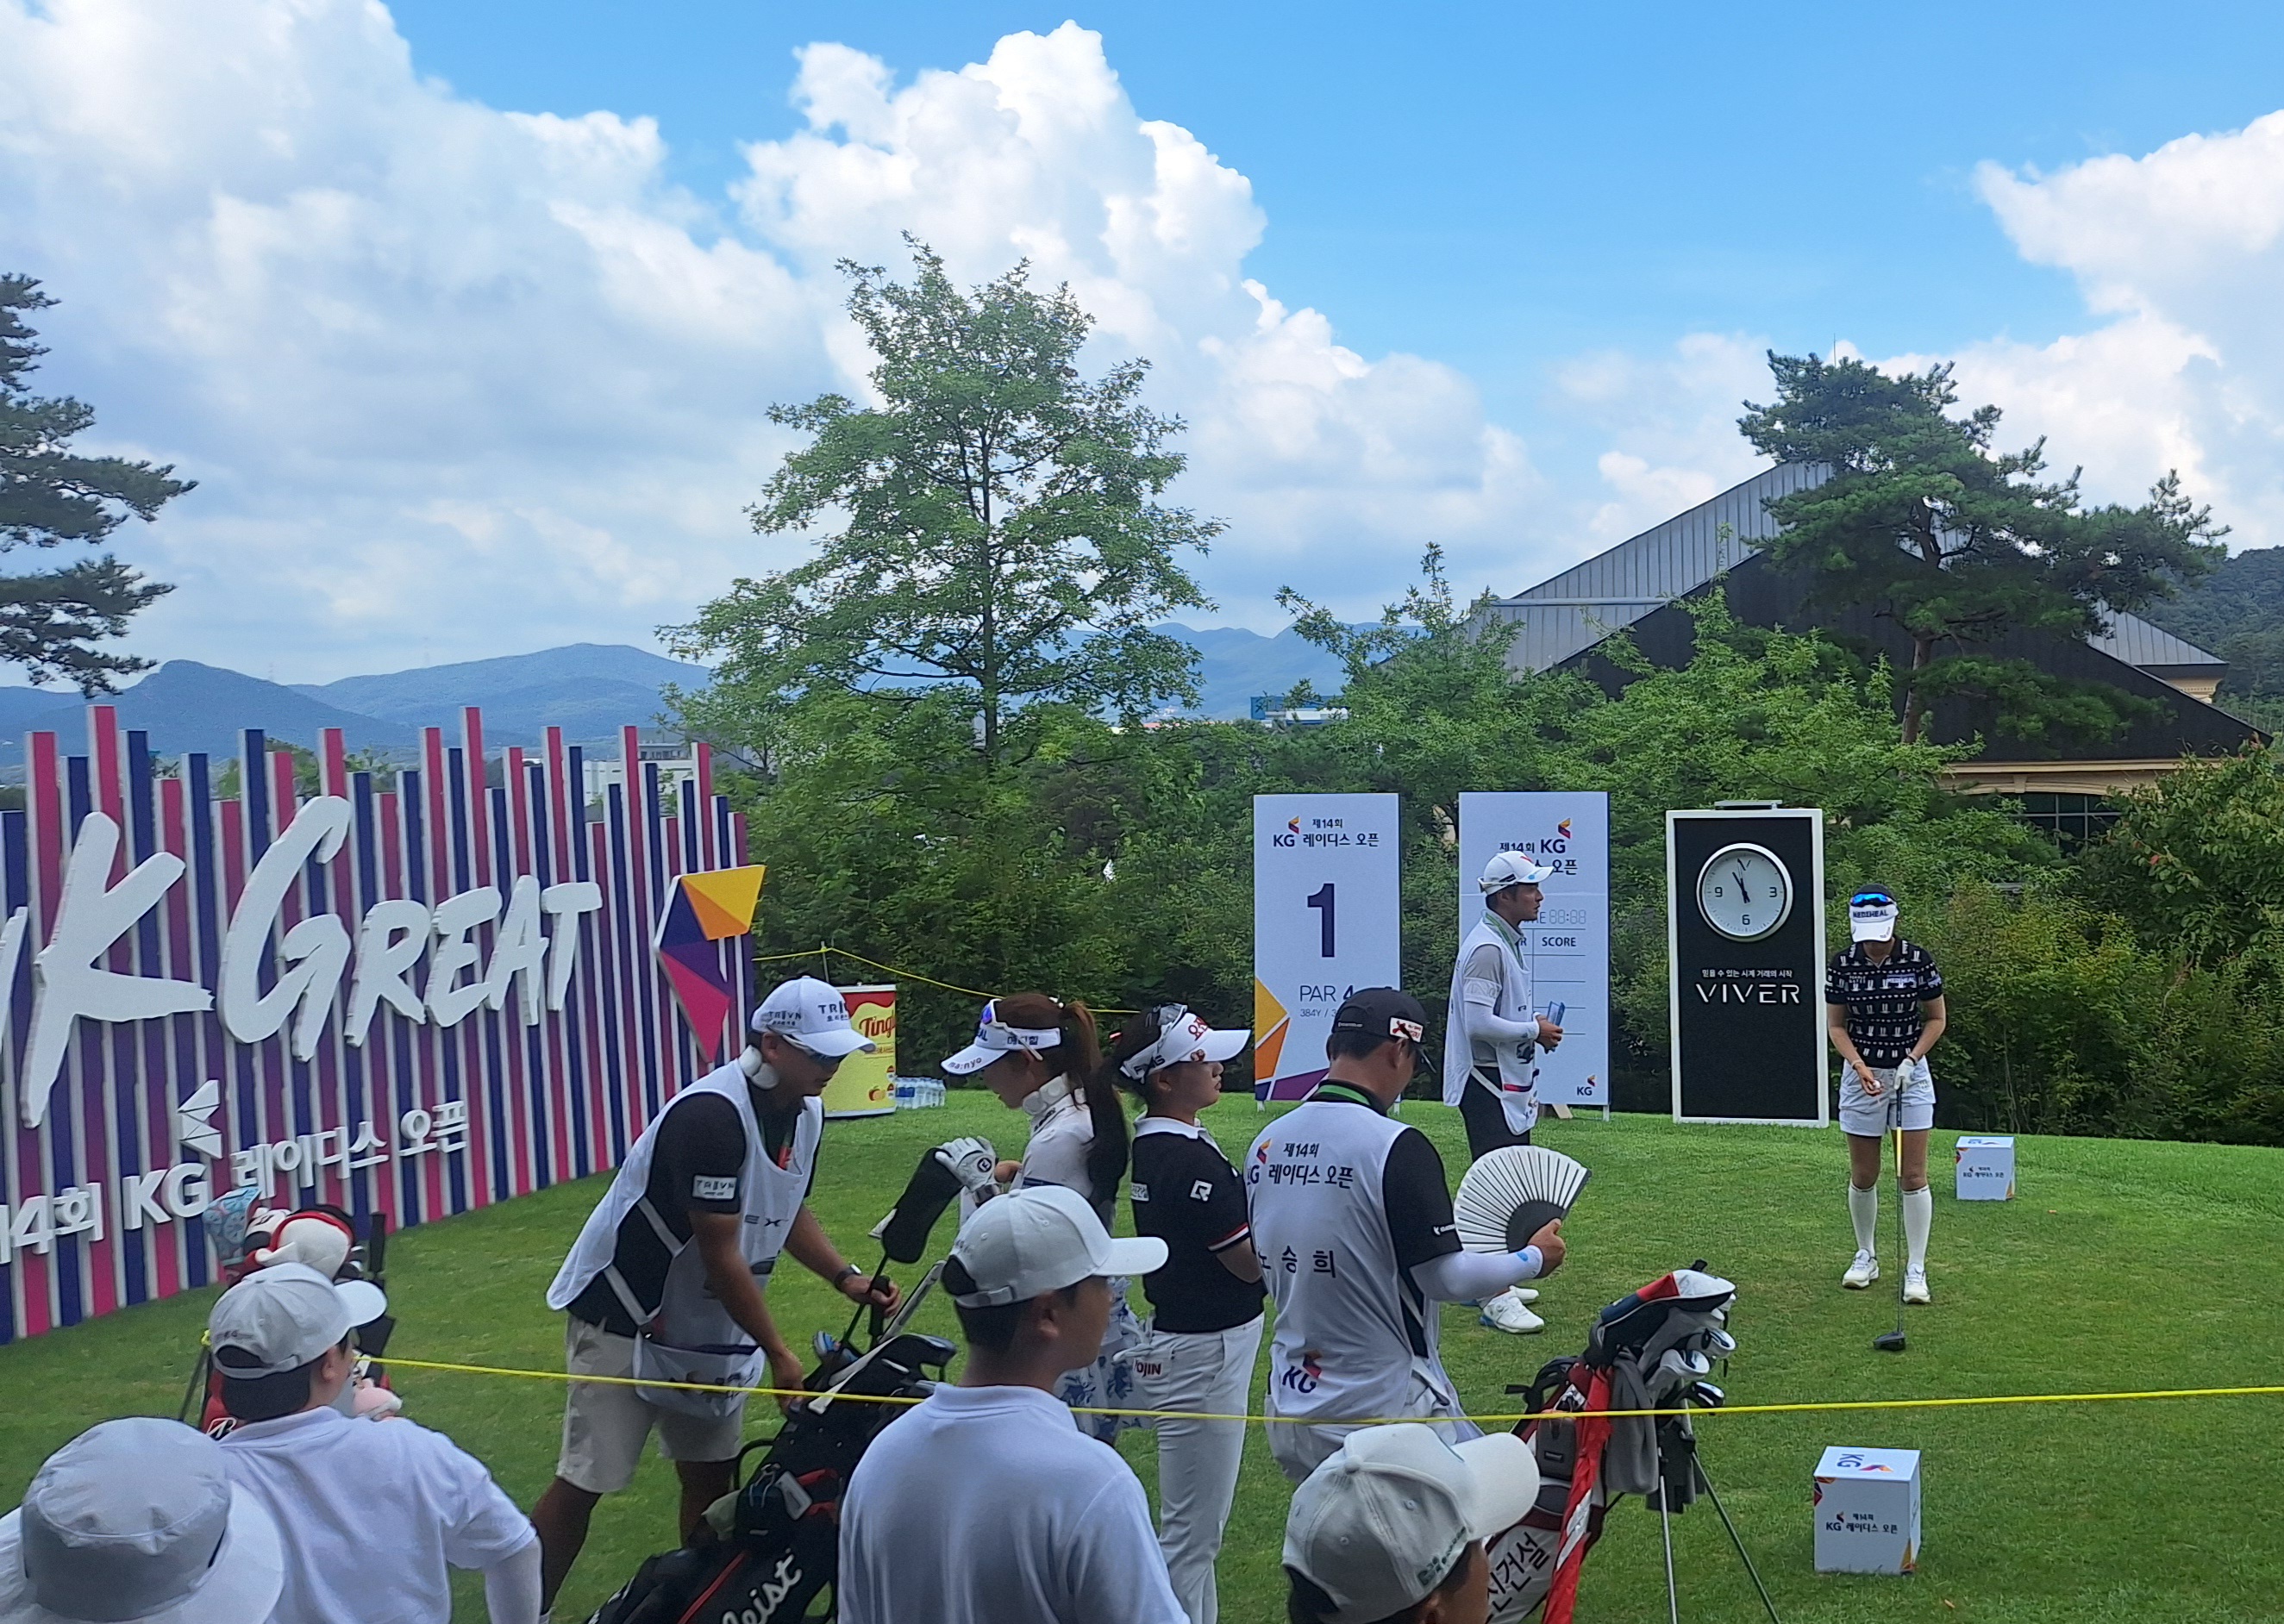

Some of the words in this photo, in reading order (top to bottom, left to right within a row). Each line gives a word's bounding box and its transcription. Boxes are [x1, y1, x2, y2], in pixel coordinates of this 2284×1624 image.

[1312, 818, 1343, 829] 제14회
[1273, 834, 1296, 847] KG
[1303, 833, 1351, 847] 레이디스
[1355, 833, 1380, 847] 오픈
[1540, 839, 1567, 854] KG
[1552, 859, 1579, 876] 오픈
[1714, 886, 1724, 898] 9
[1768, 886, 1778, 898] 3
[1306, 883, 1336, 959] 1
[1742, 914, 1751, 926] 6
[217, 795, 603, 1062] GREAT
[1541, 936, 1577, 947] SCORE
[1298, 984, 1337, 1003] PAR
[1695, 983, 1800, 1004] VIVER
[1299, 1008, 1322, 1018] 384Y
[1576, 1086, 1593, 1096] KG
[1283, 1142, 1320, 1158] 제14회
[122, 1162, 209, 1231] KG
[230, 1120, 390, 1201] 레이디스
[398, 1100, 469, 1157] 오픈
[1268, 1164, 1320, 1186] 레이디스
[1324, 1165, 1354, 1190] 오픈
[1837, 1453, 1865, 1468] KG
[1825, 1521, 1842, 1531] KG
[1846, 1522, 1878, 1533] 레이디스
[1882, 1524, 1898, 1533] 오픈
